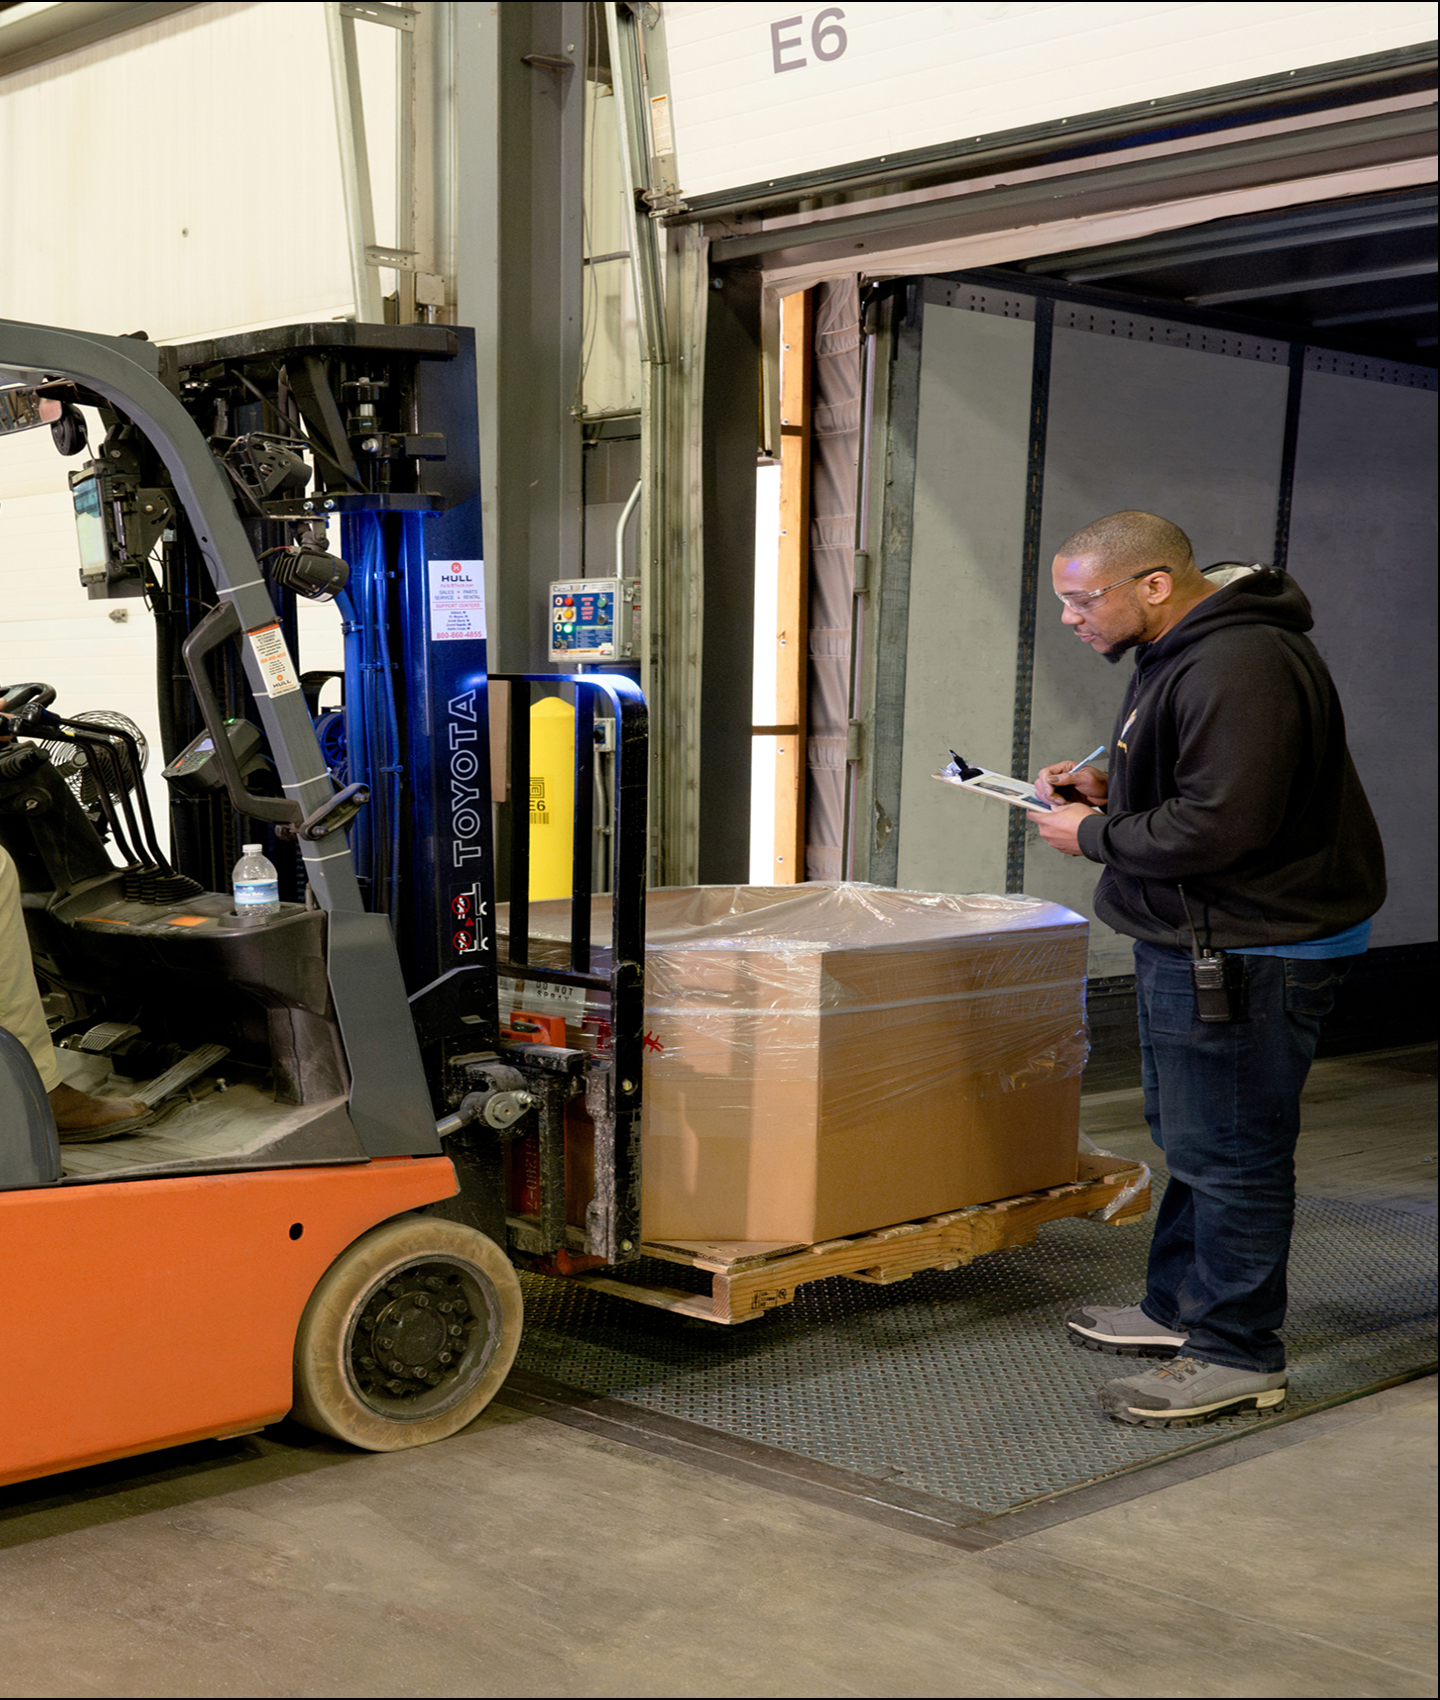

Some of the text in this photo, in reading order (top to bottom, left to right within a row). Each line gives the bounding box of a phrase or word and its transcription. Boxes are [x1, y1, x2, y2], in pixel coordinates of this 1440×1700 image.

[770, 7, 848, 74] E6
[448, 689, 481, 867] TOYOTA
[554, 985, 574, 996] NOT
